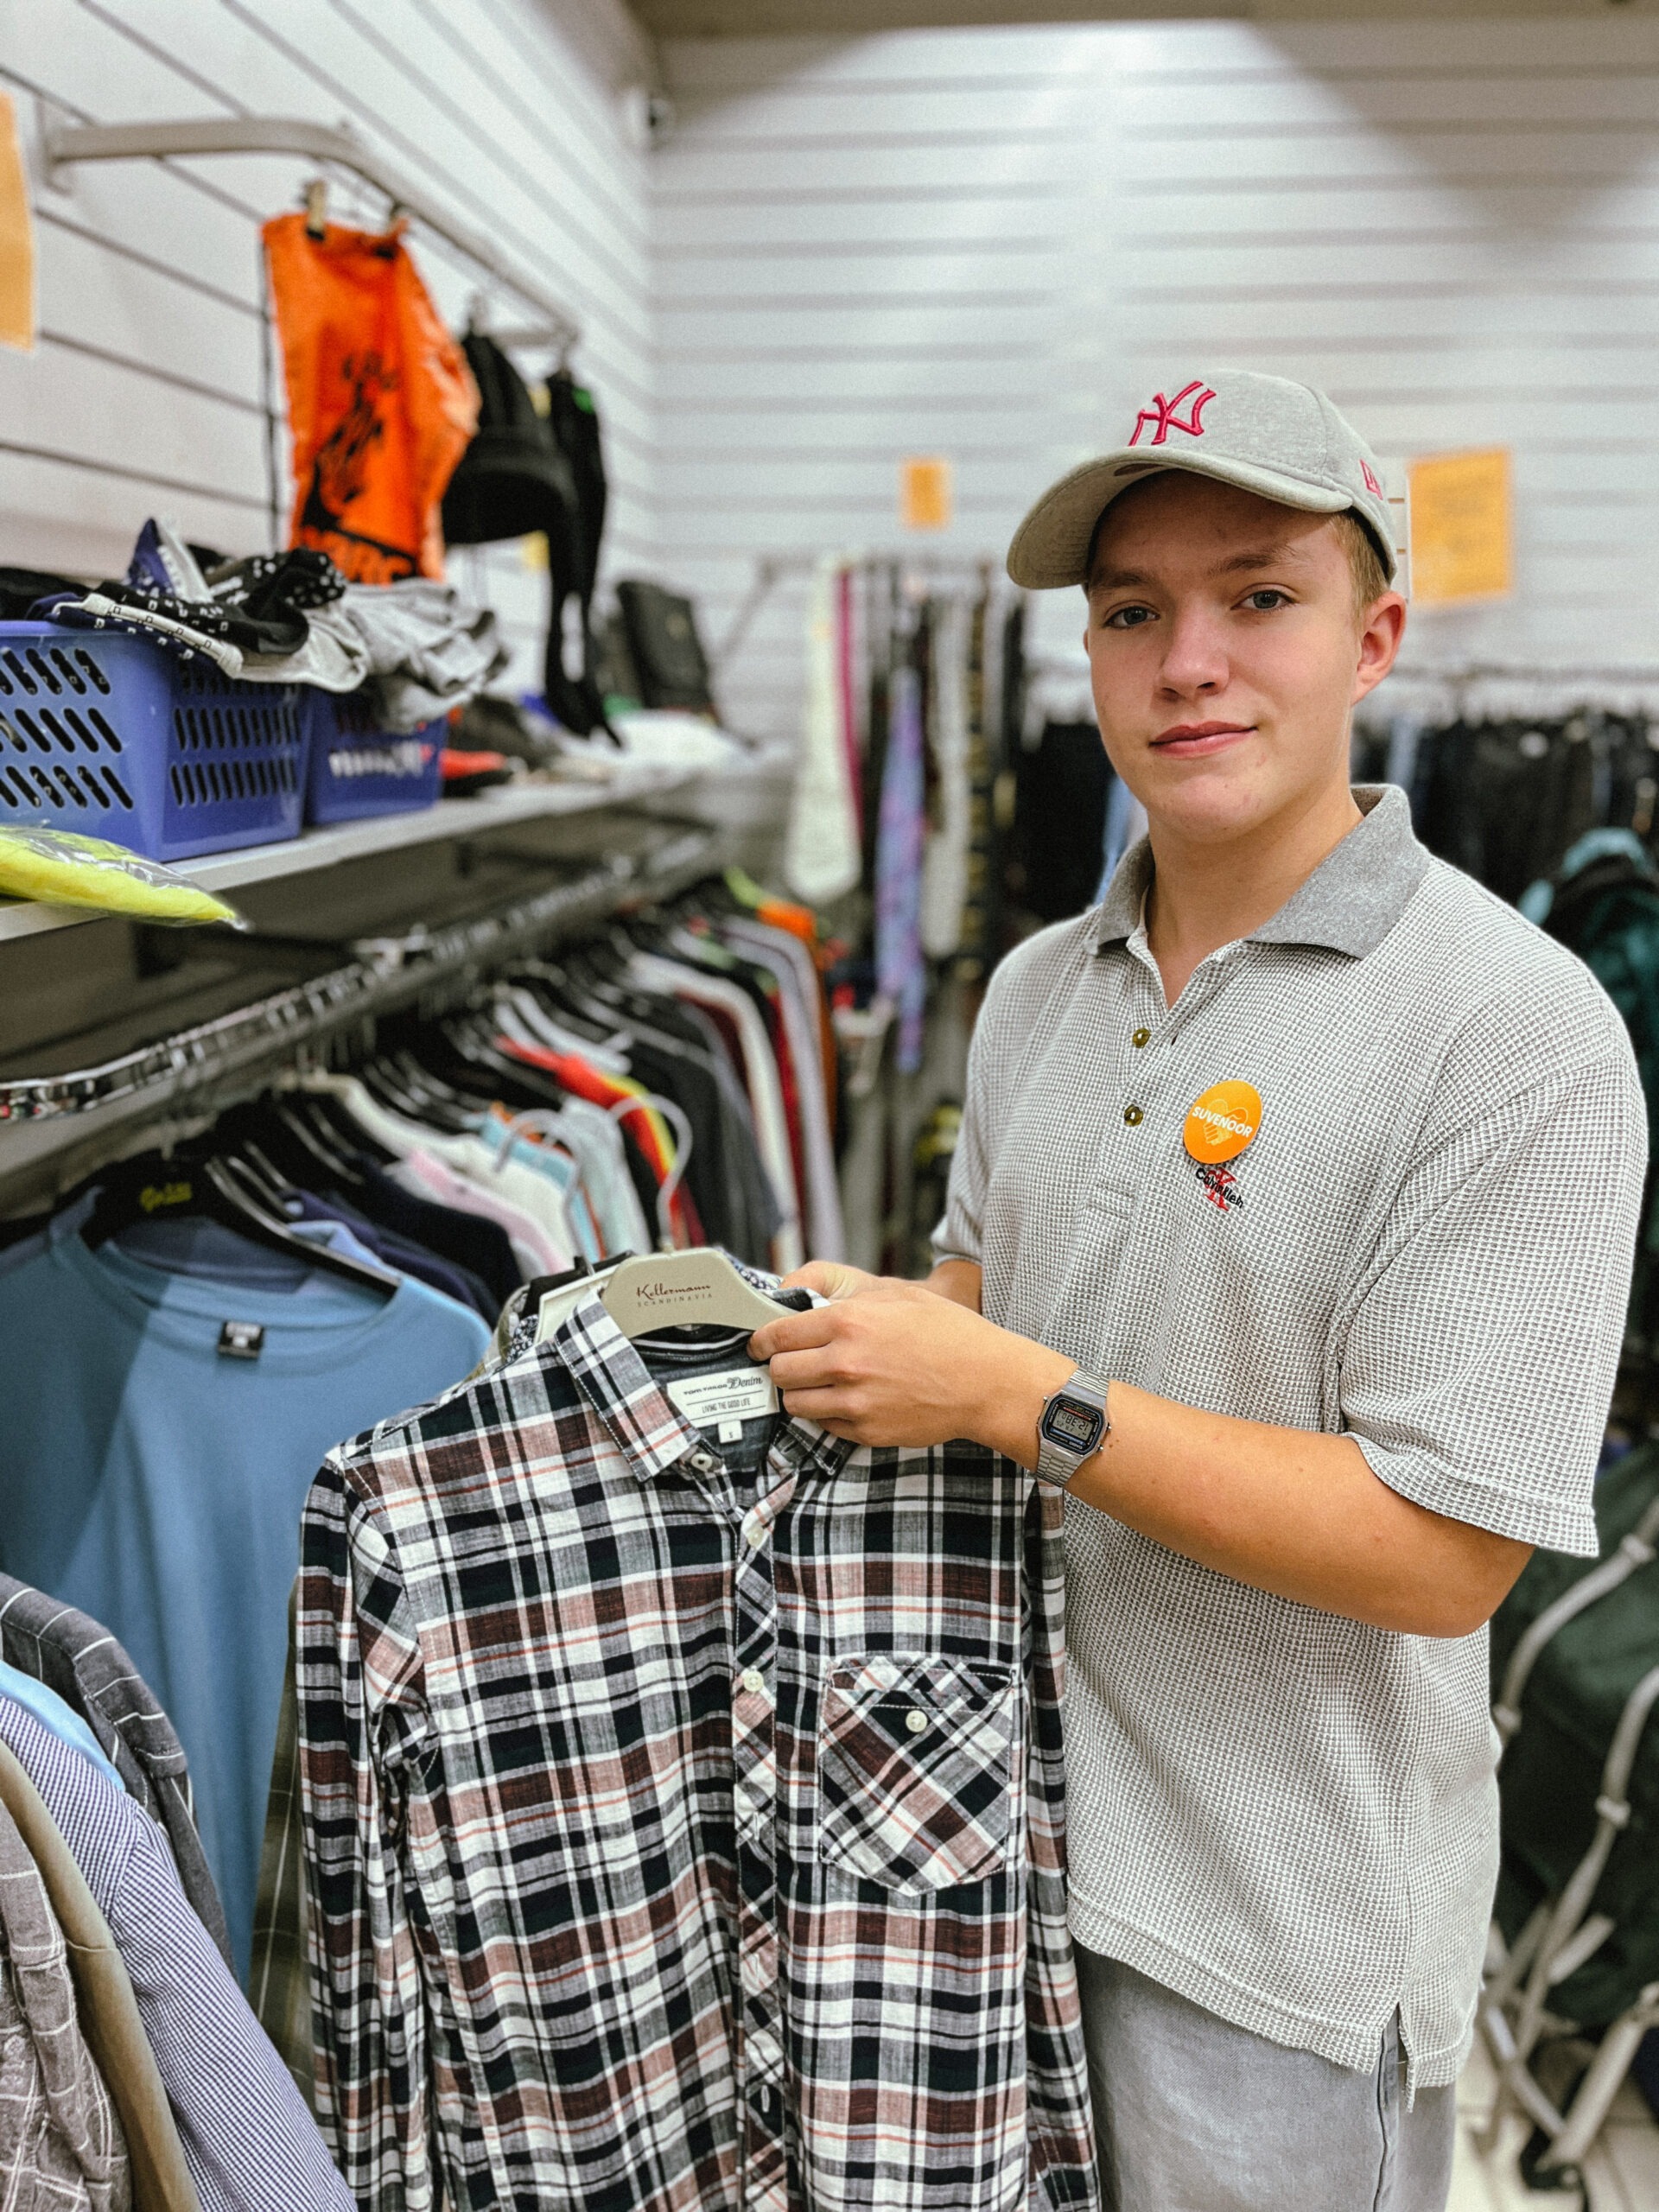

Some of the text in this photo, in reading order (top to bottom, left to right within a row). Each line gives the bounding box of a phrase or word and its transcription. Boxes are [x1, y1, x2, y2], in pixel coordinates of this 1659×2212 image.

[1128, 380, 1217, 447] NY
[1192, 1106, 1253, 1137] SUVENOOR
[637, 1282, 711, 1300] Kellermann
[638, 1294, 712, 1307] SCANDINAVIA
[727, 1376, 763, 1389] Denim
[702, 1397, 751, 1414] LIVING THE GOOD LIFE
